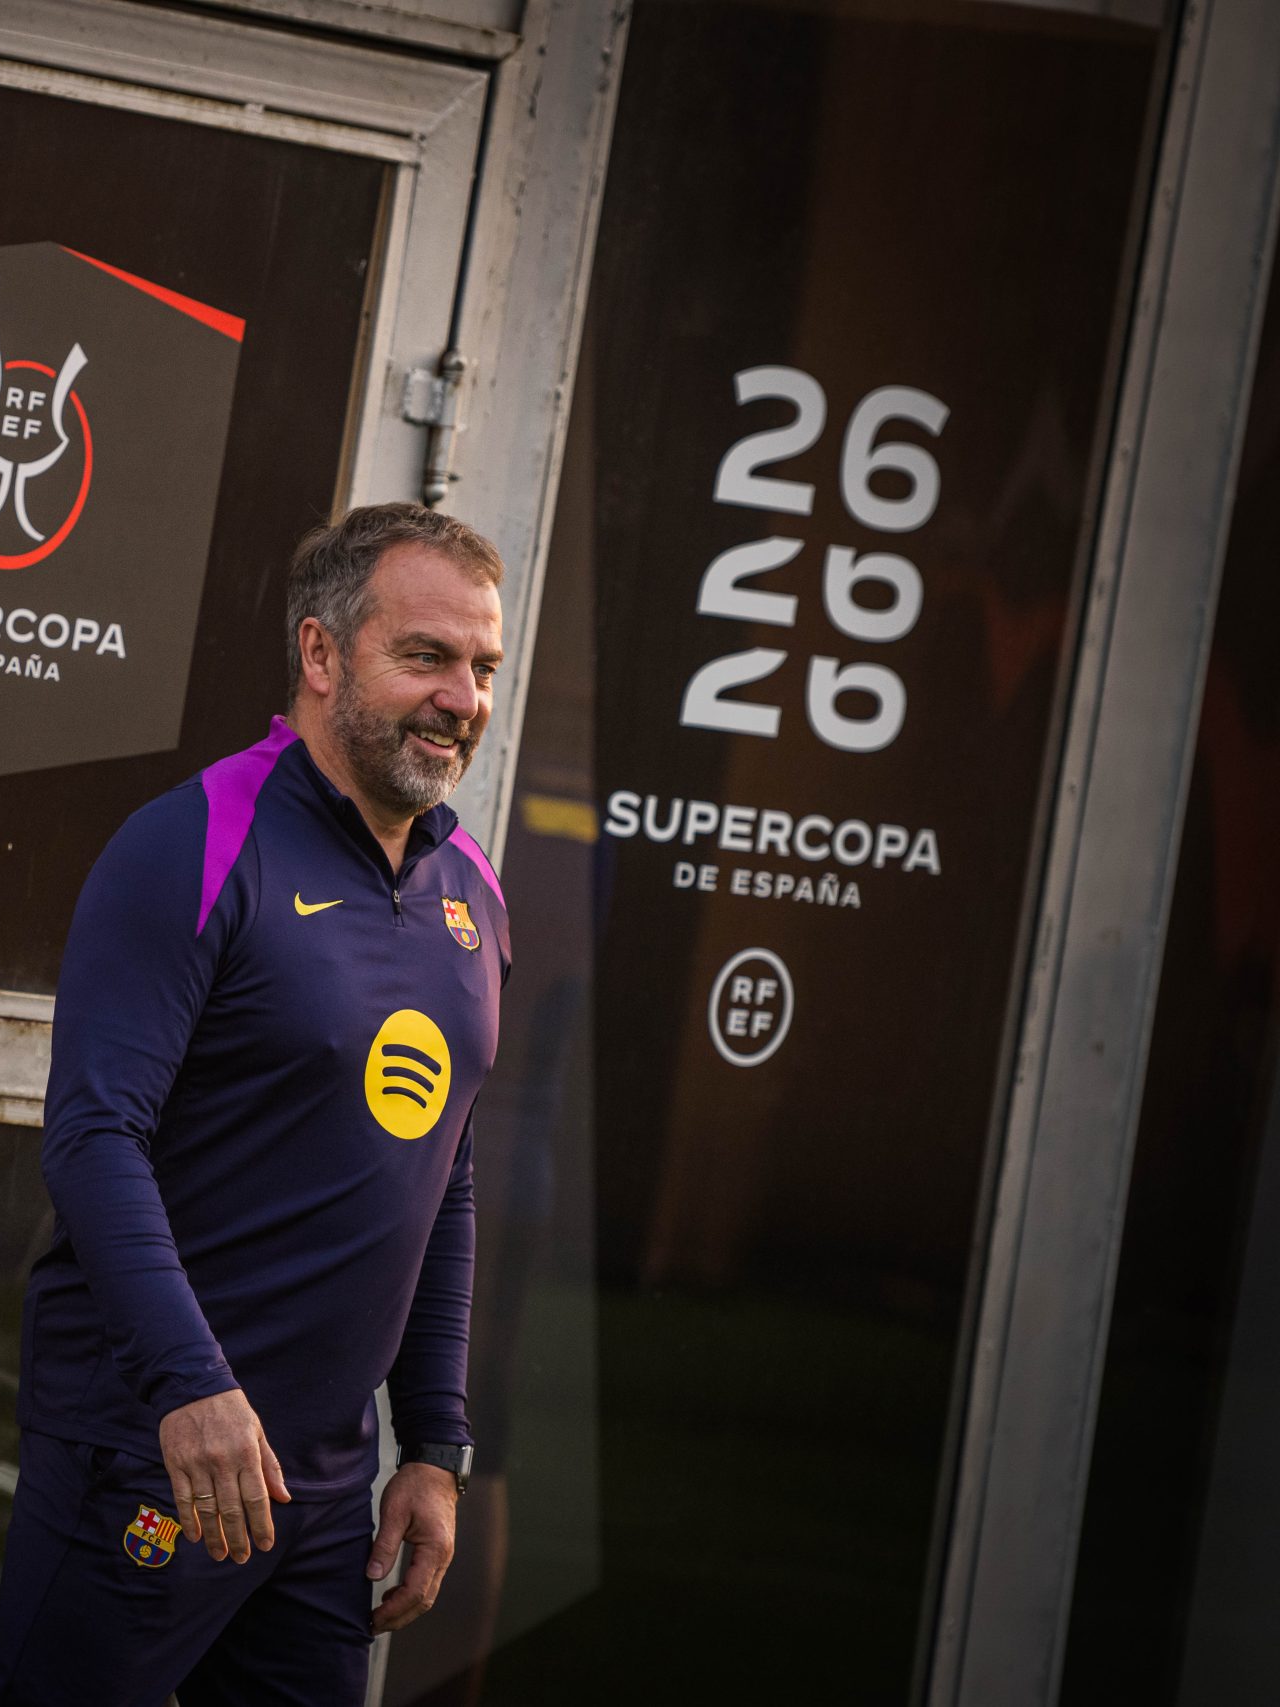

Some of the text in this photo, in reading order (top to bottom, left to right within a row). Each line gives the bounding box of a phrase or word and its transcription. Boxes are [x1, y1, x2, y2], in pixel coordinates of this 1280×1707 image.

[5, 387, 46, 411] RF
[1, 414, 42, 439] EF
[714, 364, 951, 533] 26
[605, 790, 941, 875] SUPERCOPA
[674, 862, 861, 909] DE ESPAÑA
[731, 976, 778, 1005] RF
[727, 1009, 773, 1038] EF
[141, 1530, 161, 1545] FCB
